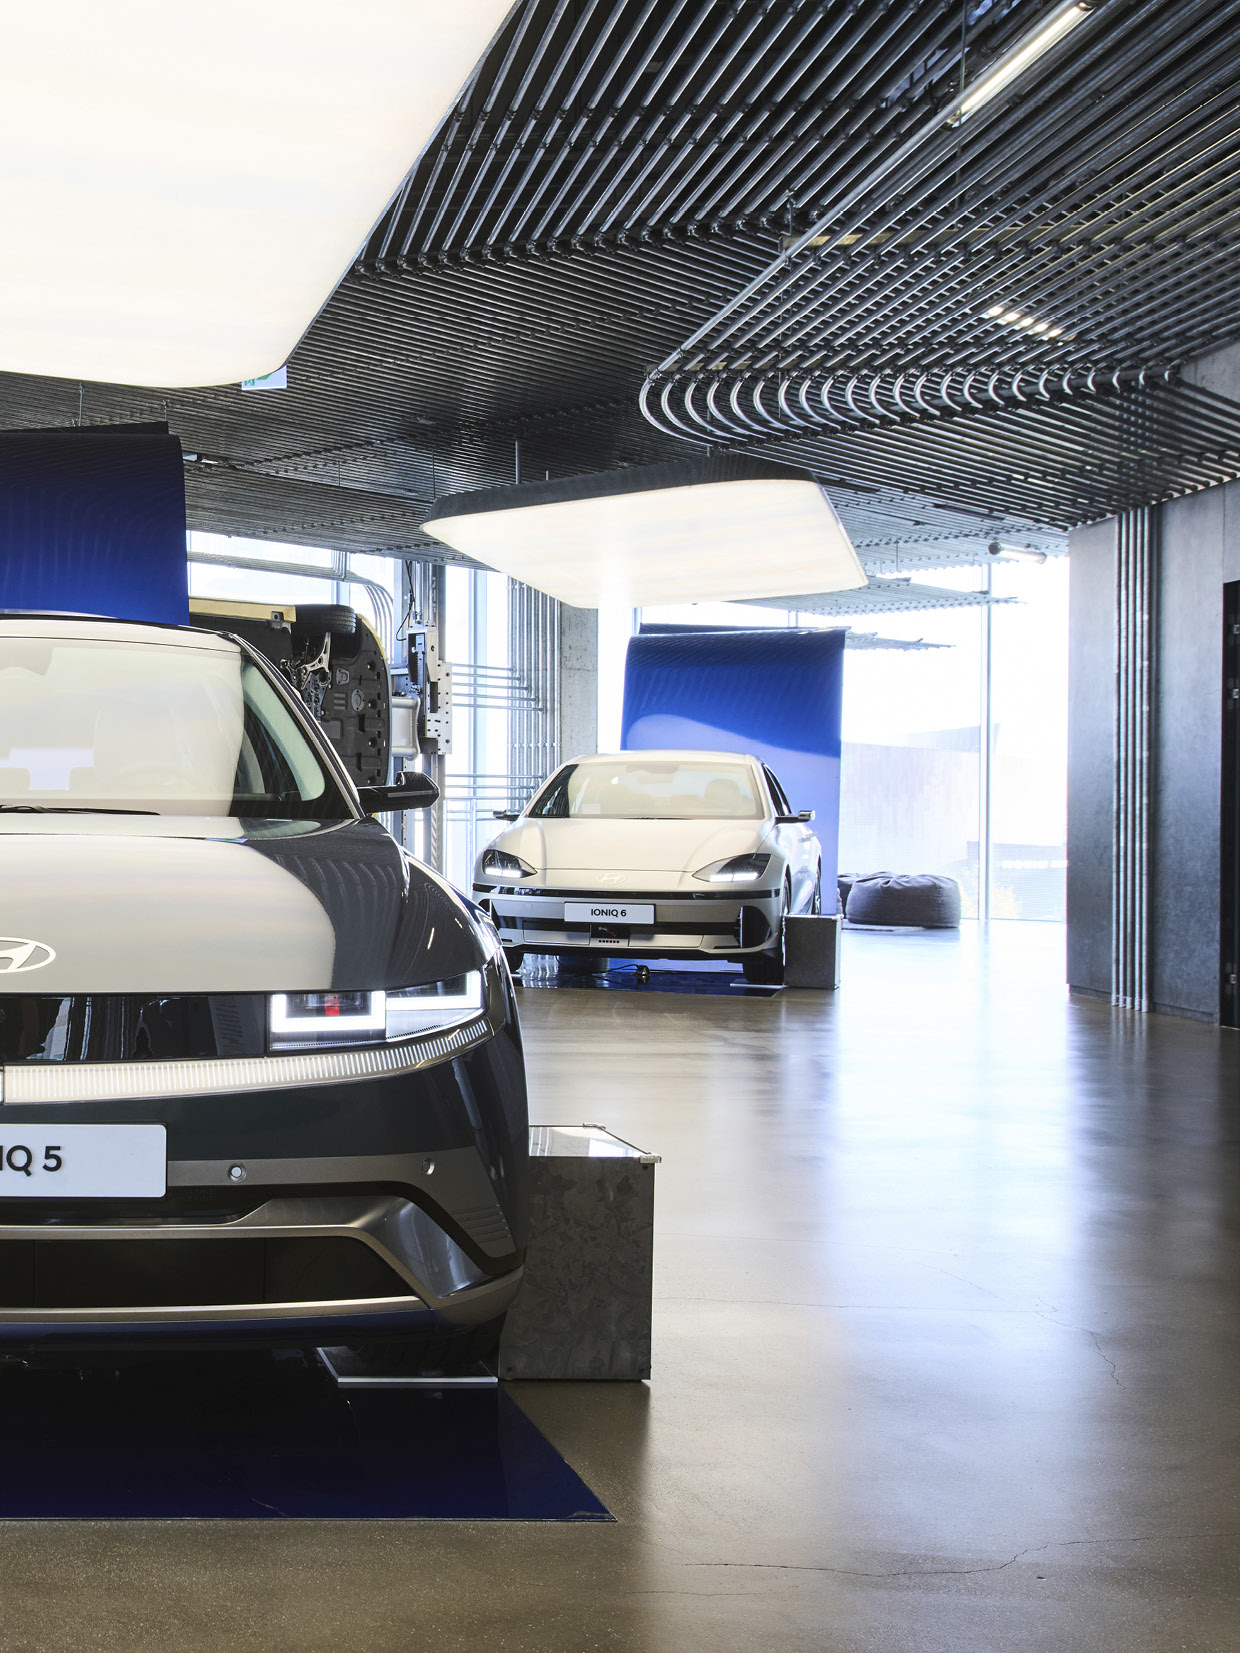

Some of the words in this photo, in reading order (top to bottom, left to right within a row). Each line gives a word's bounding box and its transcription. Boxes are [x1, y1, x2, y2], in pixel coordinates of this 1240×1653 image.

[591, 908, 619, 918] IONIQ
[620, 909, 627, 917] 6
[42, 1145, 63, 1172] 5
